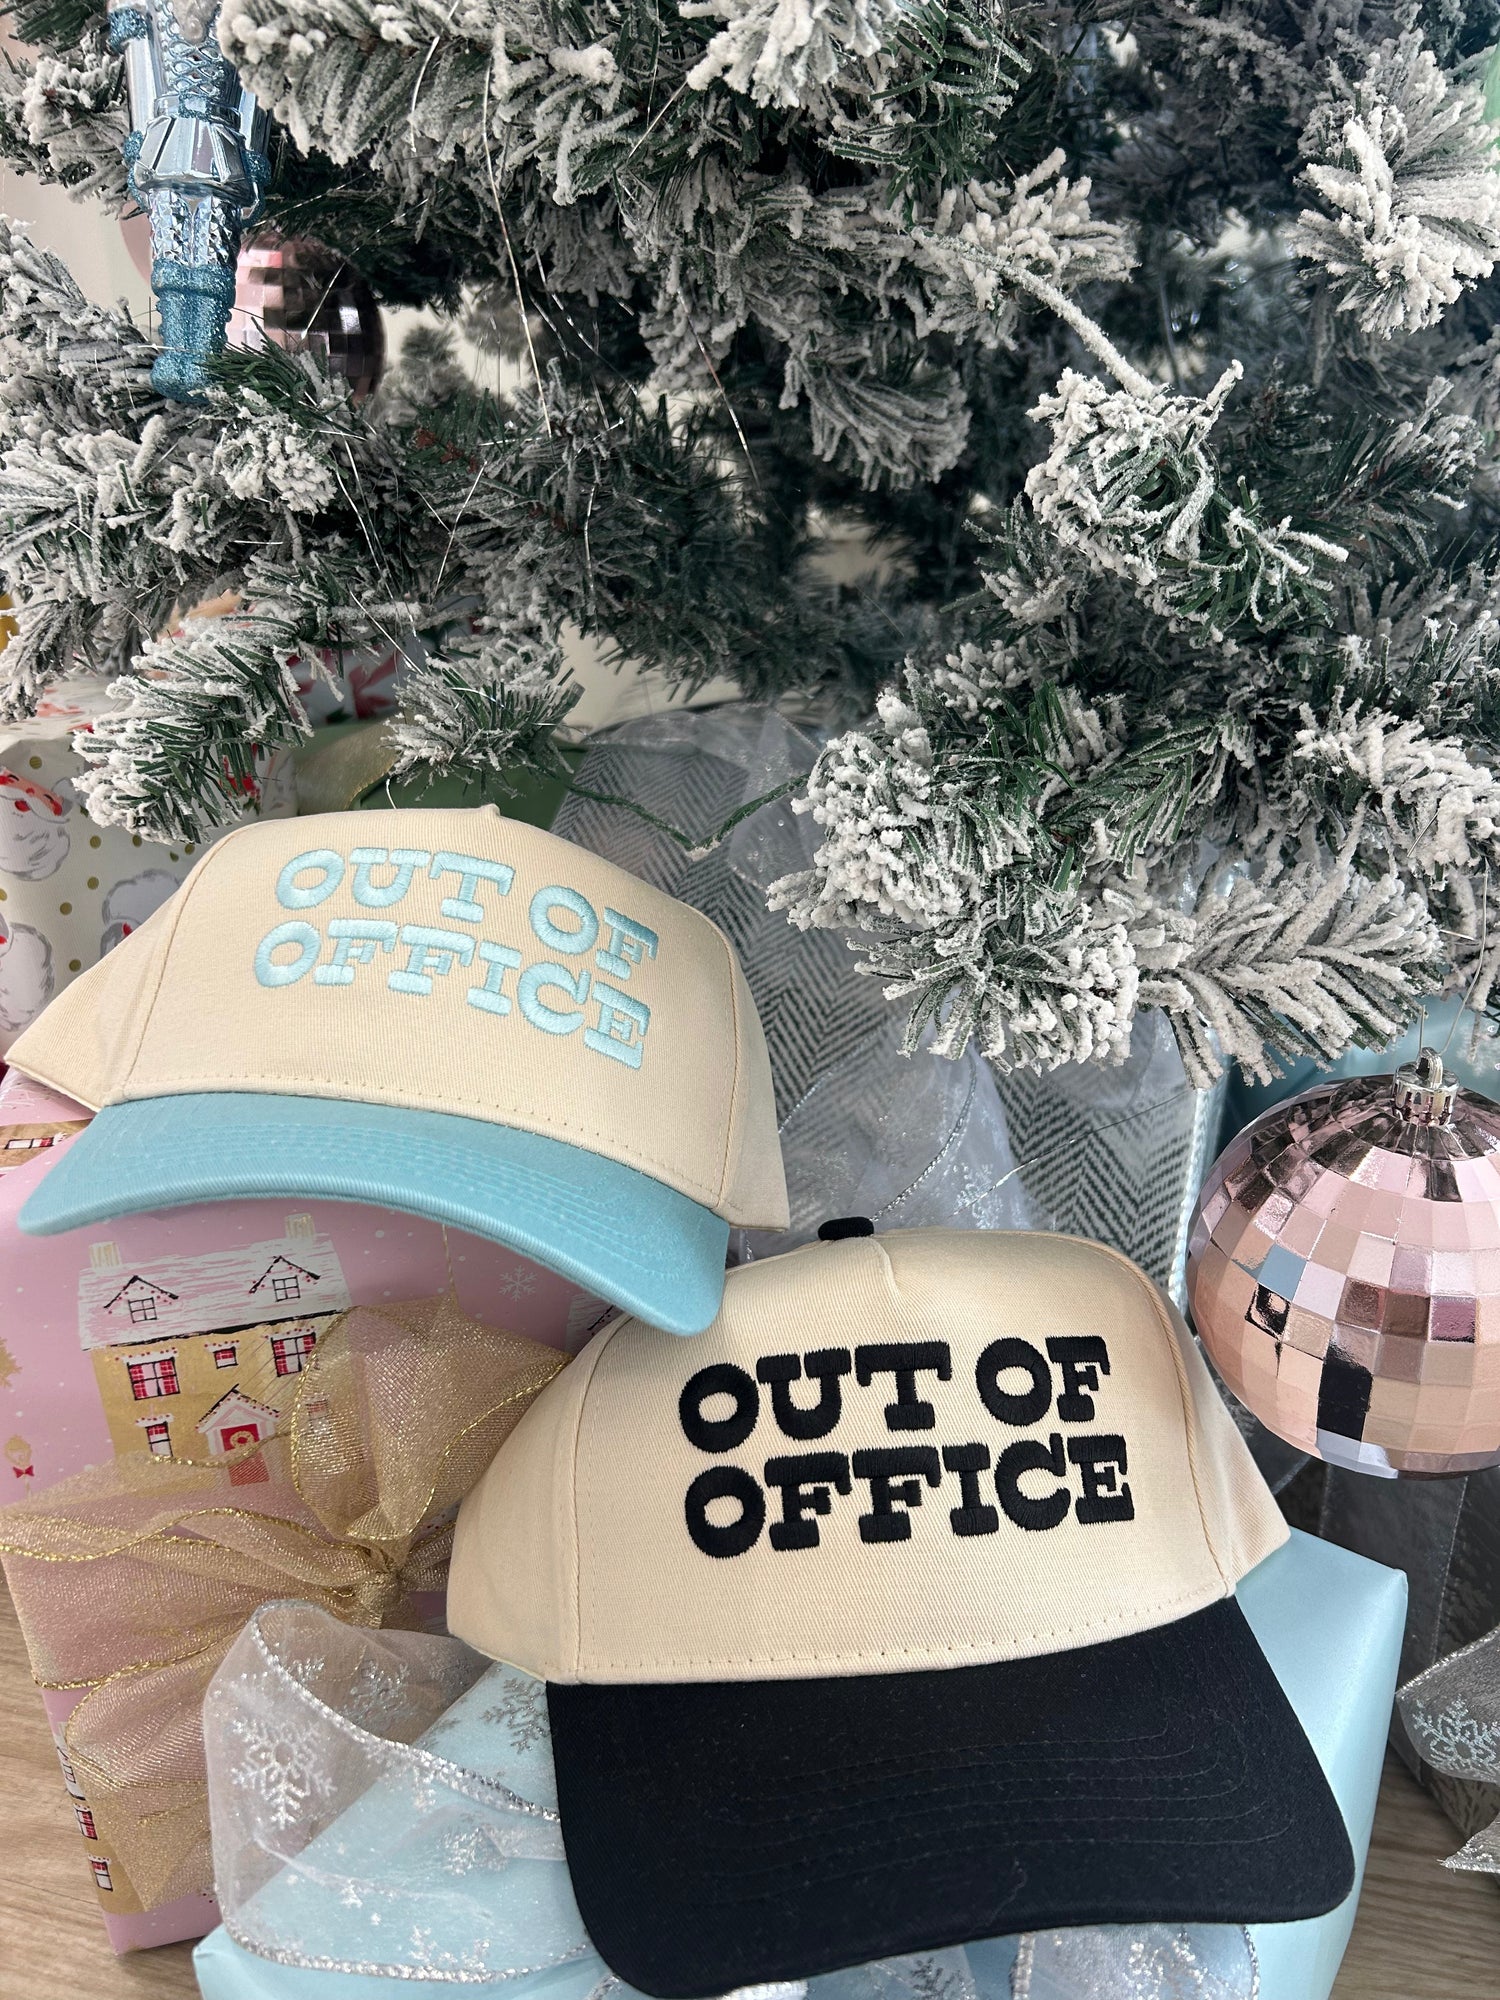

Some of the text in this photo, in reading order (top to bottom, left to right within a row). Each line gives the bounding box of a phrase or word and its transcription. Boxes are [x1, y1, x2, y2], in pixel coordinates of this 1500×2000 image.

[275, 847, 659, 980] OUT OF
[254, 918, 651, 1069] OFFICE
[678, 1335, 1110, 1454] OUT OF
[685, 1432, 1135, 1559] OFFICE
